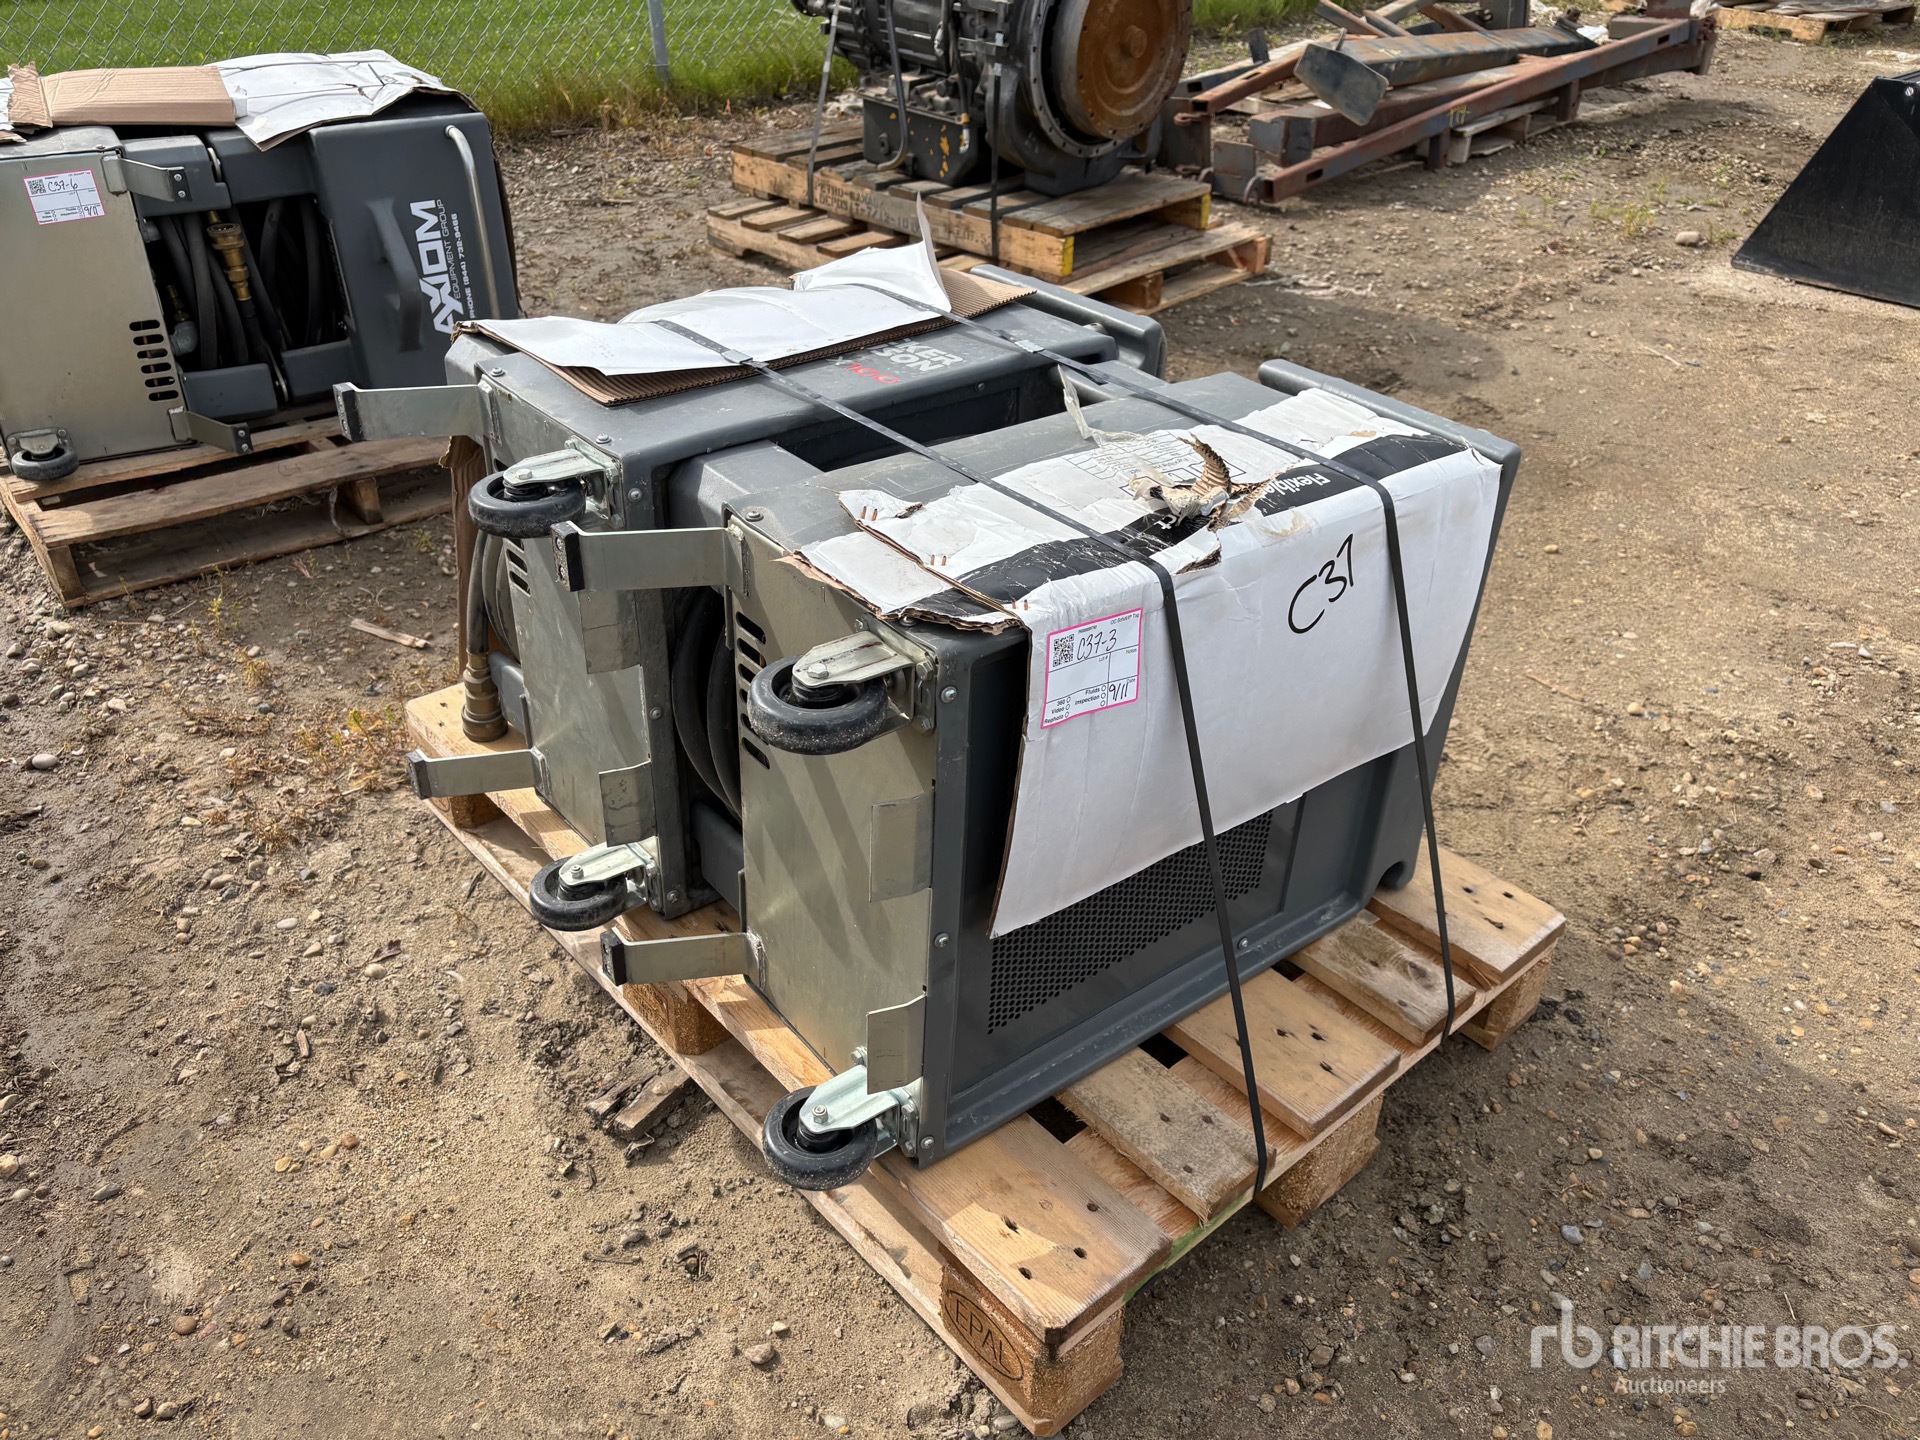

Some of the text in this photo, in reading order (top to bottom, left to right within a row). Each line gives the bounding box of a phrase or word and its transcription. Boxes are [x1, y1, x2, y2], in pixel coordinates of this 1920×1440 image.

[47, 178, 79, 192] C37-6
[436, 199, 461, 299] EQUIPMENT GROUP
[409, 199, 464, 335] AXIOM
[460, 261, 470, 285] (844)
[464, 287, 476, 319] PHONE
[1287, 533, 1355, 635] C37
[1076, 628, 1117, 661] C37-3
[1074, 695, 1100, 706] Inspection
[1085, 687, 1100, 695] Fluids
[1108, 683, 1129, 702] 9/11
[1051, 706, 1065, 714] Video
[955, 1298, 1012, 1375] EPAL
